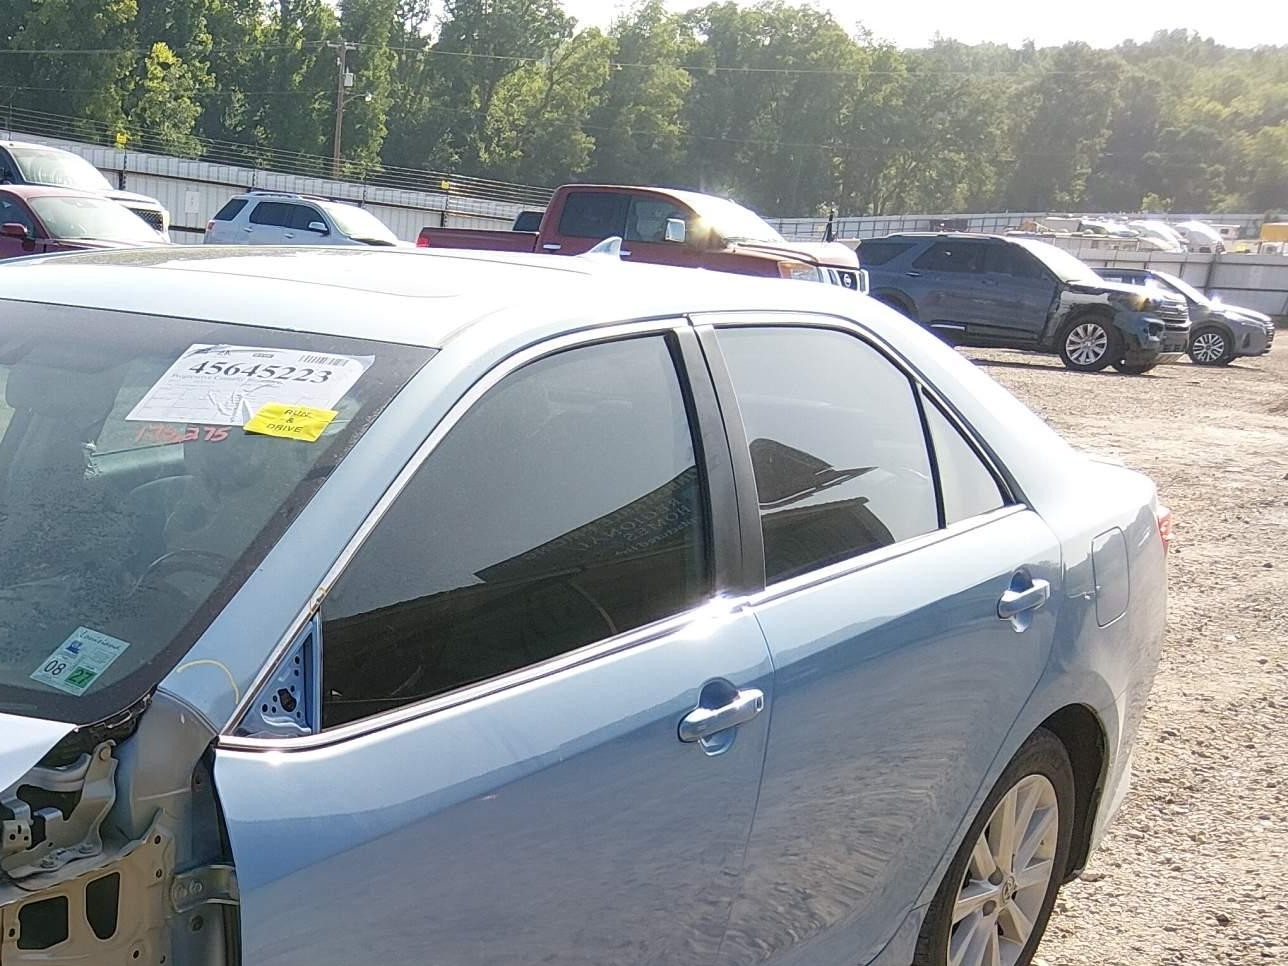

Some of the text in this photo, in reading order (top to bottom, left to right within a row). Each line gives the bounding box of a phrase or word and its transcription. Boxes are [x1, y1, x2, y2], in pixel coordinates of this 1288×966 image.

[189, 360, 332, 384] 45645223
[266, 423, 304, 433] DRIVE
[44, 659, 67, 676] 08
[69, 668, 95, 685] 27
